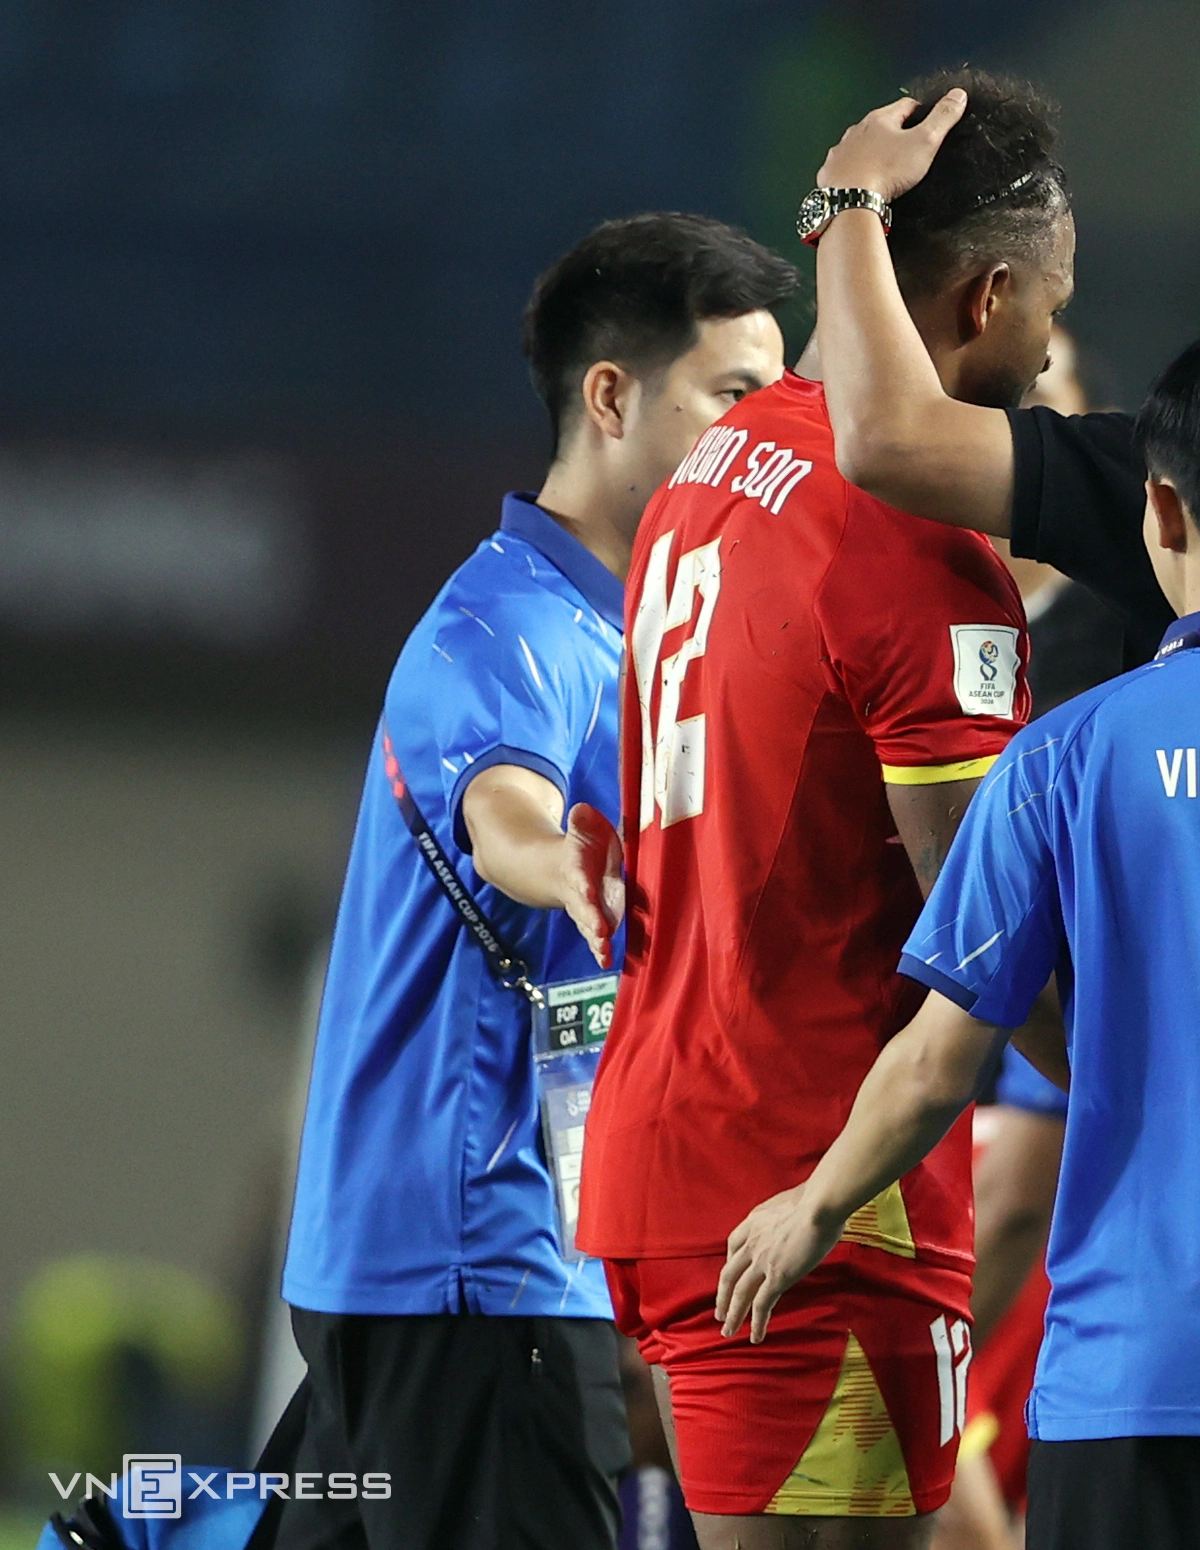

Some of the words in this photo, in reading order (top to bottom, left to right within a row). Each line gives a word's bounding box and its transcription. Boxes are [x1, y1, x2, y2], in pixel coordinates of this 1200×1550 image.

[731, 441, 813, 516] SON
[632, 529, 722, 831] 12
[419, 831, 439, 861] FIFA
[433, 859, 463, 900] ASEAN
[458, 899, 480, 923] CUP
[556, 1004, 579, 1024] FOP
[586, 1001, 615, 1031] 26
[559, 1028, 578, 1046] OA
